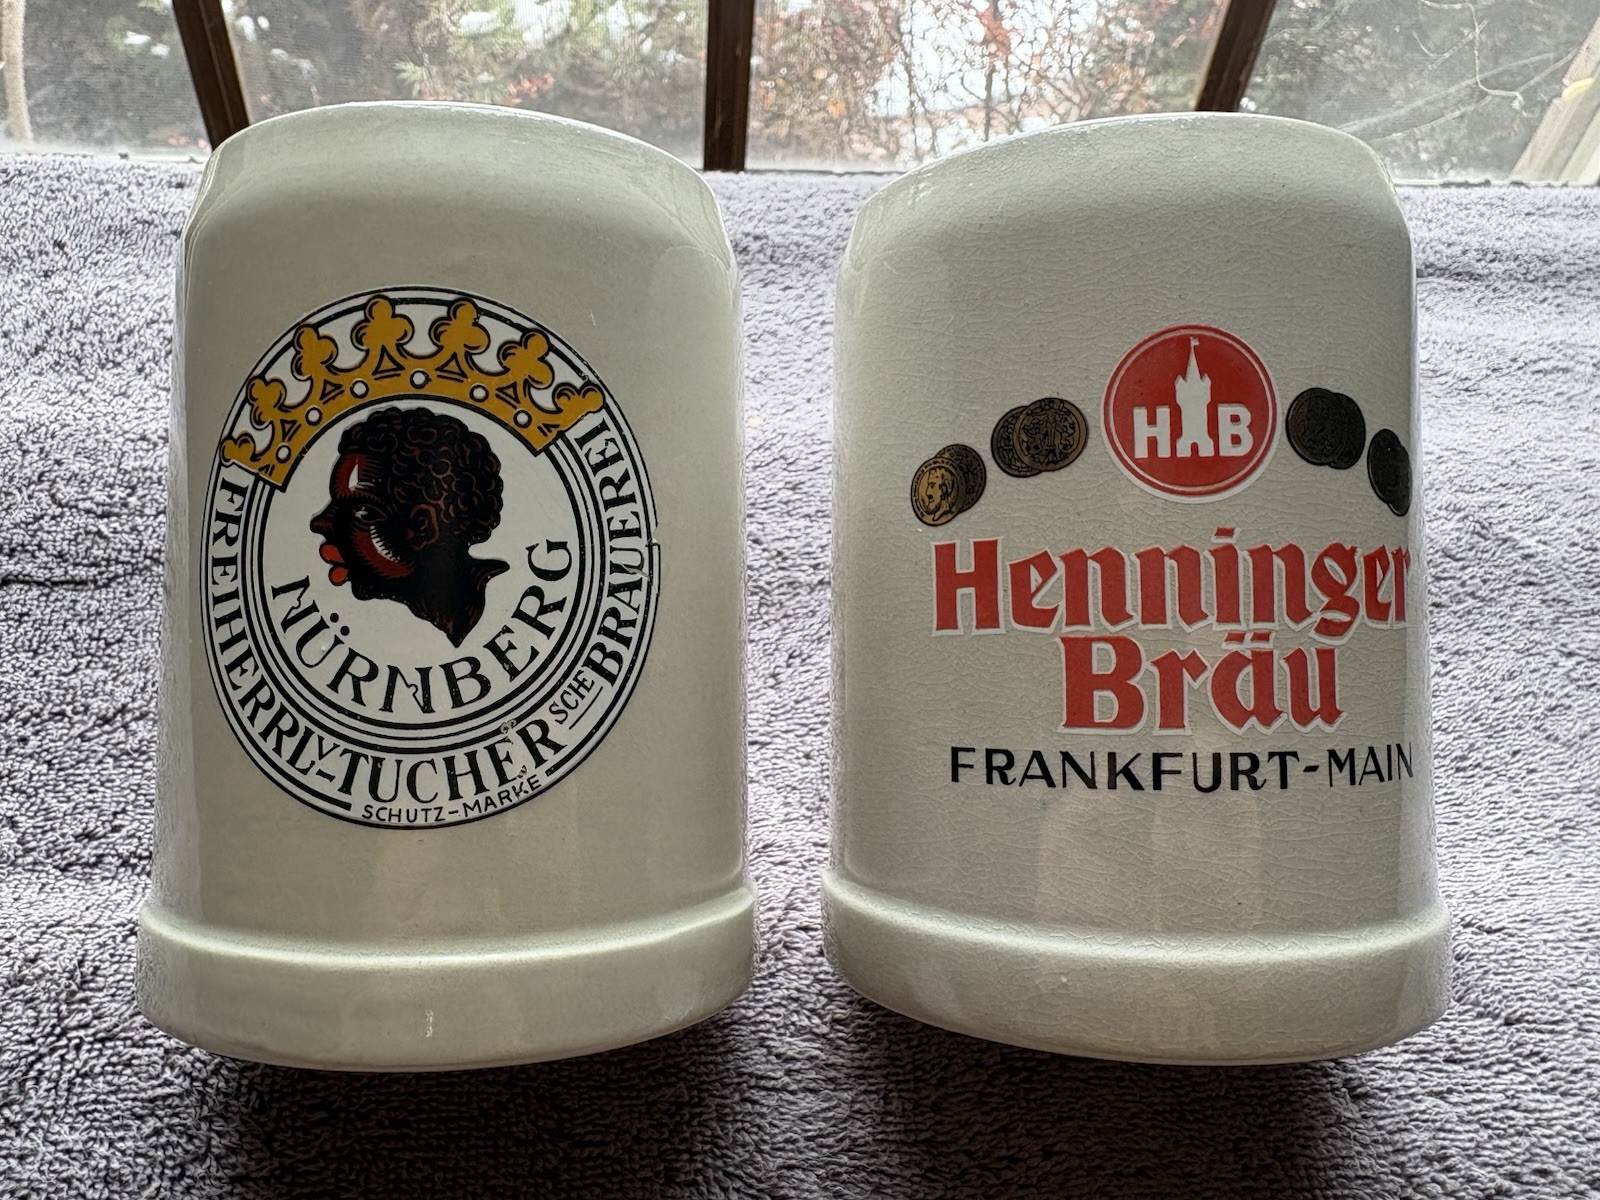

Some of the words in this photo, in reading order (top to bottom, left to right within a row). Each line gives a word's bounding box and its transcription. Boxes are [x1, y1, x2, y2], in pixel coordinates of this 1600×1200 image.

[574, 417, 644, 688] BRAUEREI
[931, 526, 1412, 643] Henninger
[270, 538, 573, 715] NÜRNBERG
[1057, 630, 1347, 735] Bräu
[361, 773, 542, 823] SCHUTZ-MARKE
[950, 742, 1415, 794] FRANKFURT-MAIN
